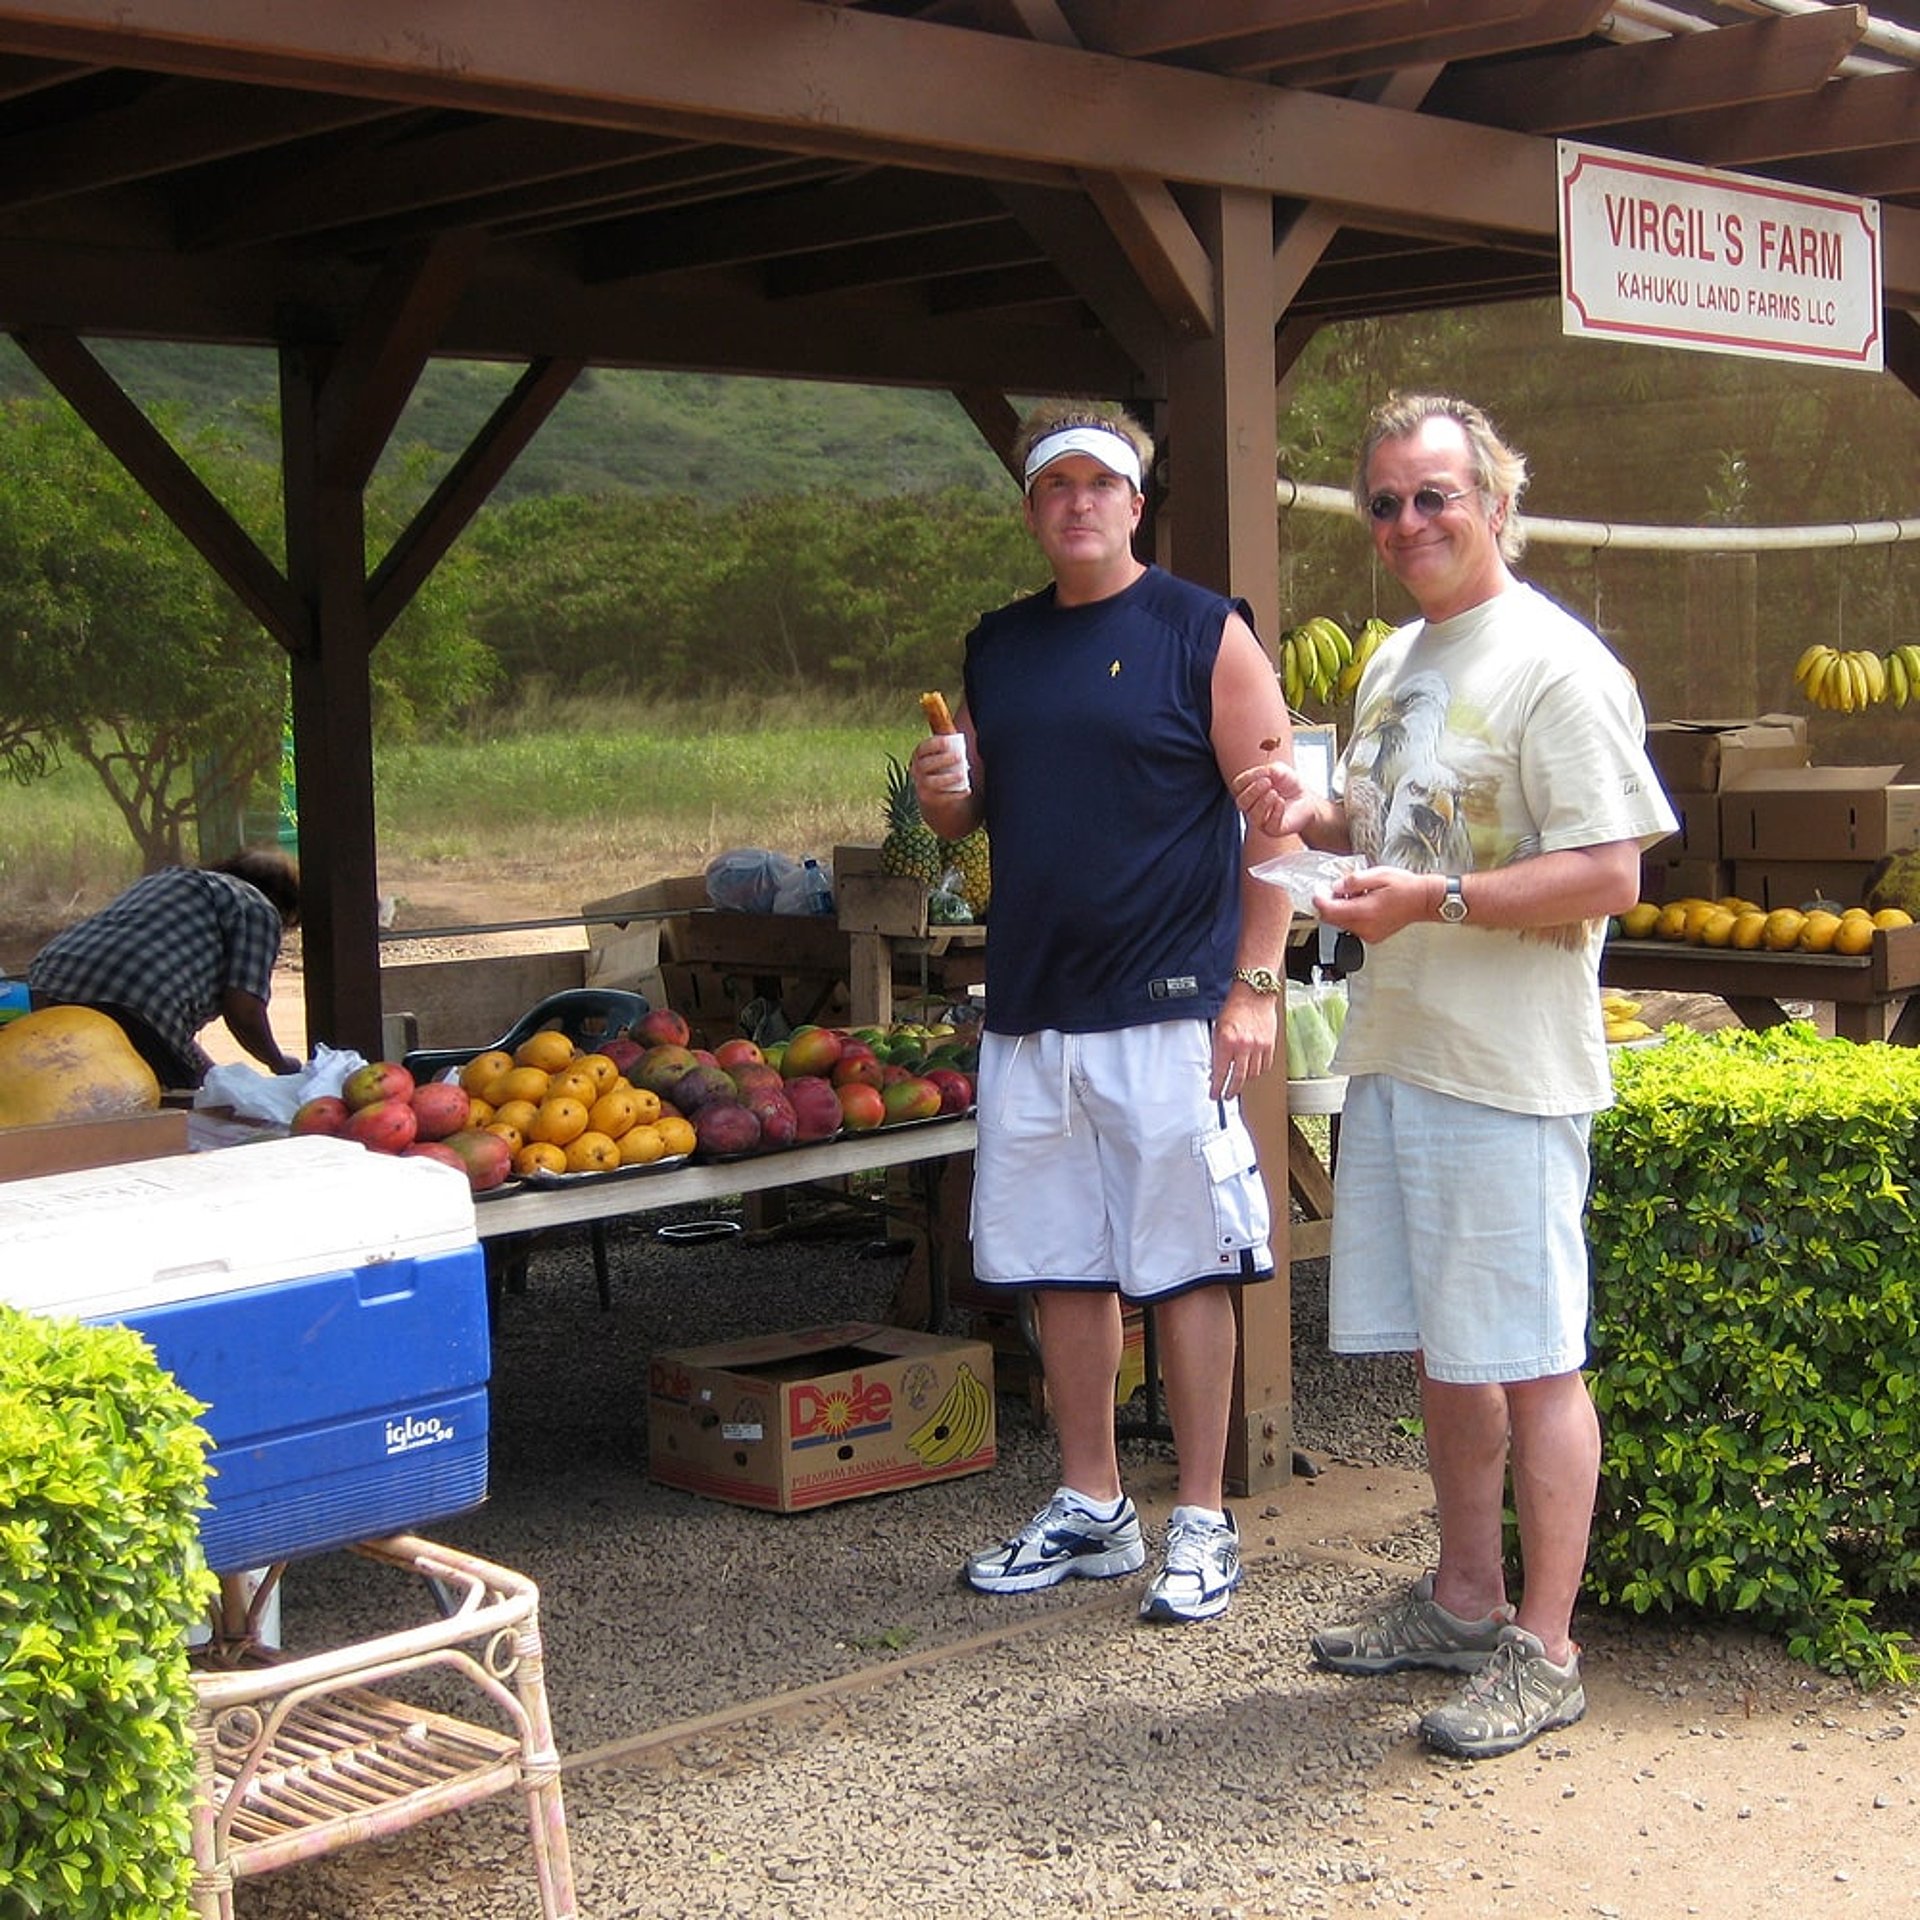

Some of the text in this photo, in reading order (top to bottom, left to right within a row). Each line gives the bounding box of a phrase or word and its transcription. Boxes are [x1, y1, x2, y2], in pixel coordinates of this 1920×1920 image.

[1604, 193, 1843, 281] VIRGIL'S FARM
[1617, 271, 1835, 326] KAHUKU LAND FARMS LLC
[386, 1416, 440, 1446] igloo
[789, 1373, 893, 1438] Dole
